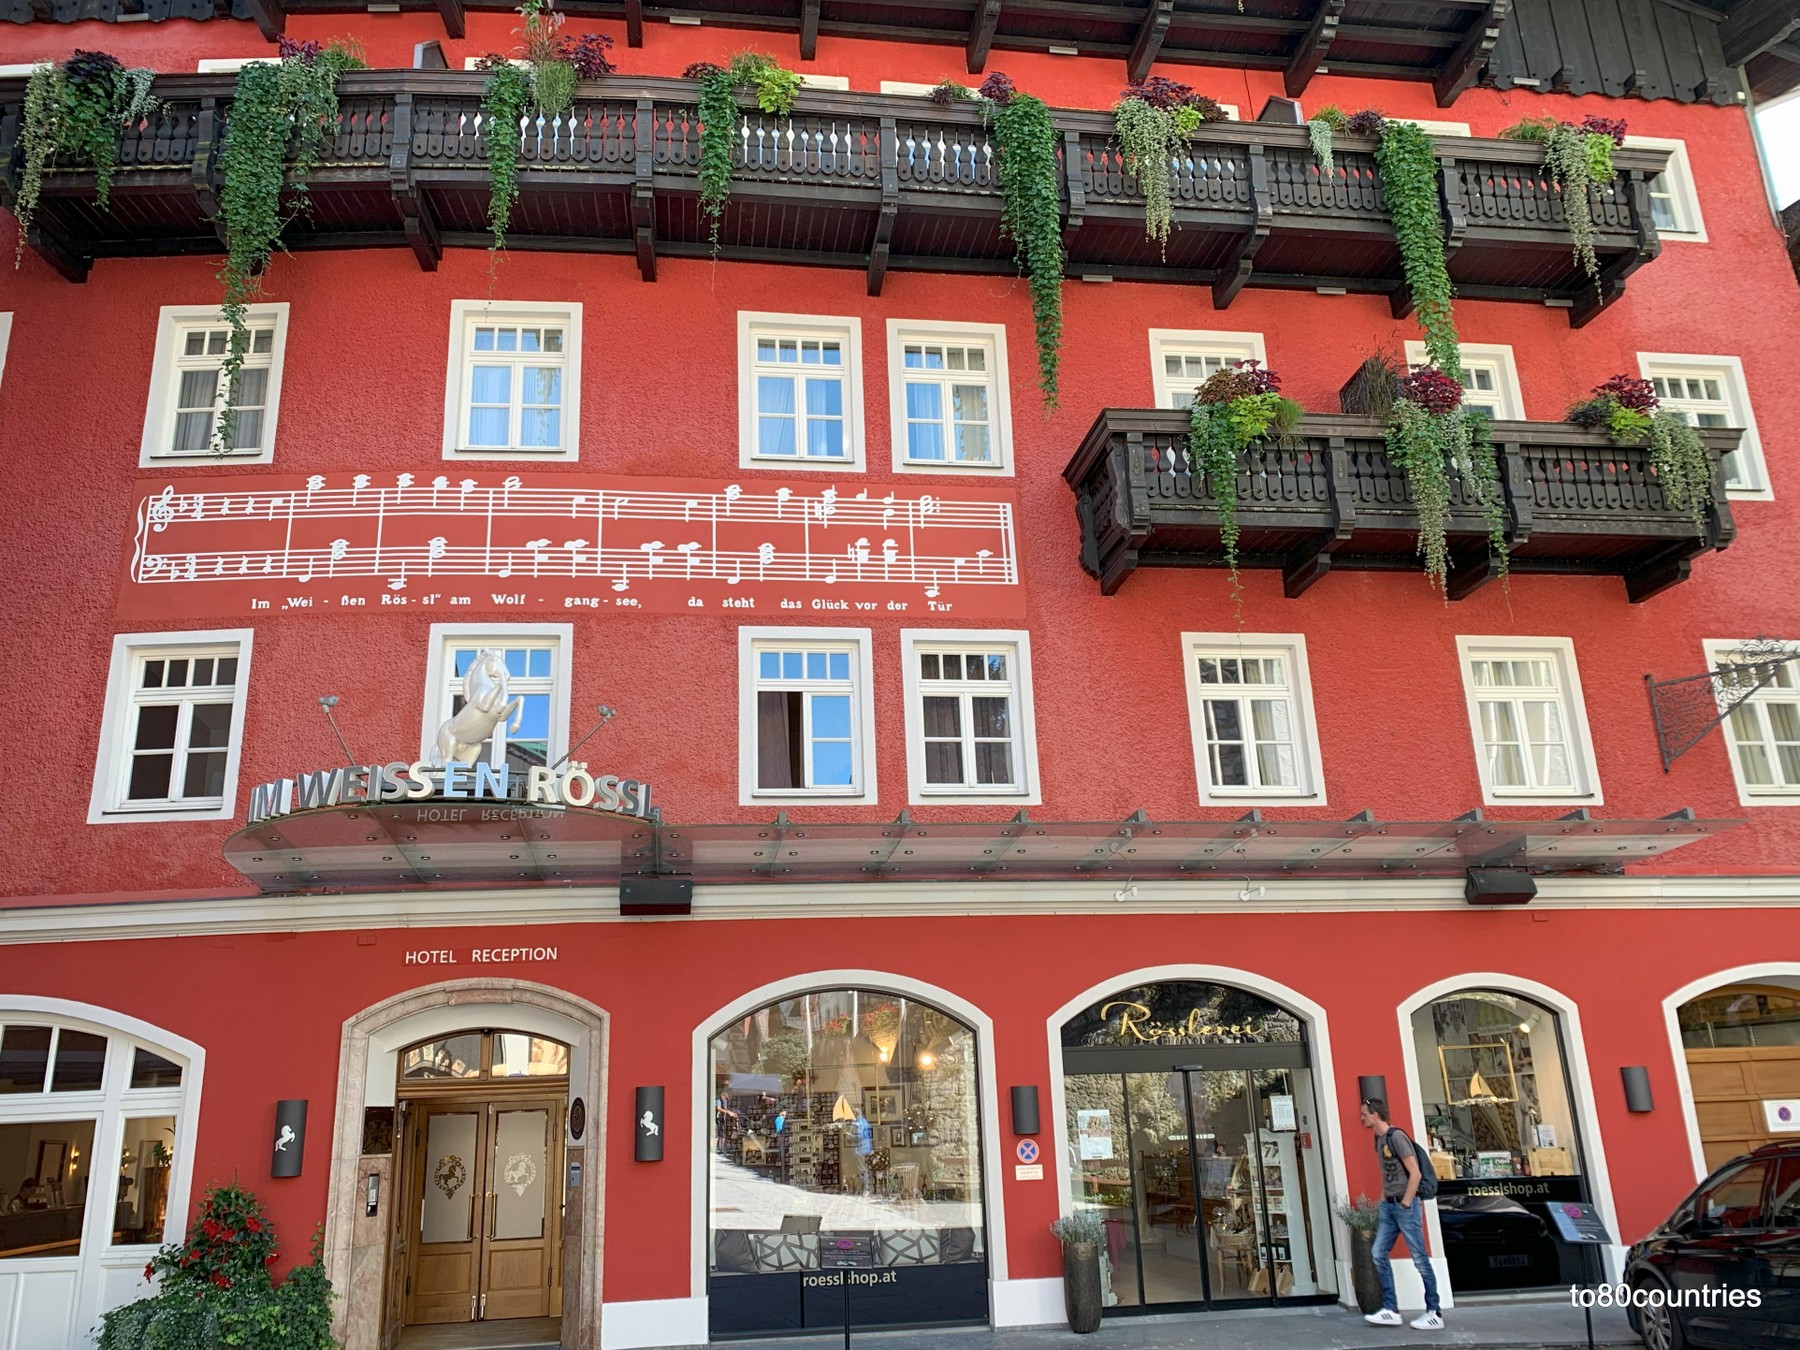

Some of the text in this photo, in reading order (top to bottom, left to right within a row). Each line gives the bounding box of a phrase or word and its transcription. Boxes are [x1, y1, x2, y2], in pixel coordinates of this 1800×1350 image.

[251, 598, 270, 609] Im
[340, 594, 366, 606] ßen
[449, 596, 472, 605] am
[490, 593, 527, 605] Wolf
[615, 597, 642, 609] see,
[687, 596, 705, 608] da
[721, 597, 756, 609] steht
[780, 598, 803, 610] das
[811, 598, 850, 610] Glück
[854, 601, 878, 611] vor
[886, 599, 909, 611] der
[927, 600, 953, 612] Tür
[248, 760, 662, 823] IM WEISSEN RÖSSL
[405, 947, 558, 964] HOTEL RECEPTION
[1100, 1001, 1263, 1041] Rösslerei
[1467, 1181, 1550, 1198] roesslshop.at
